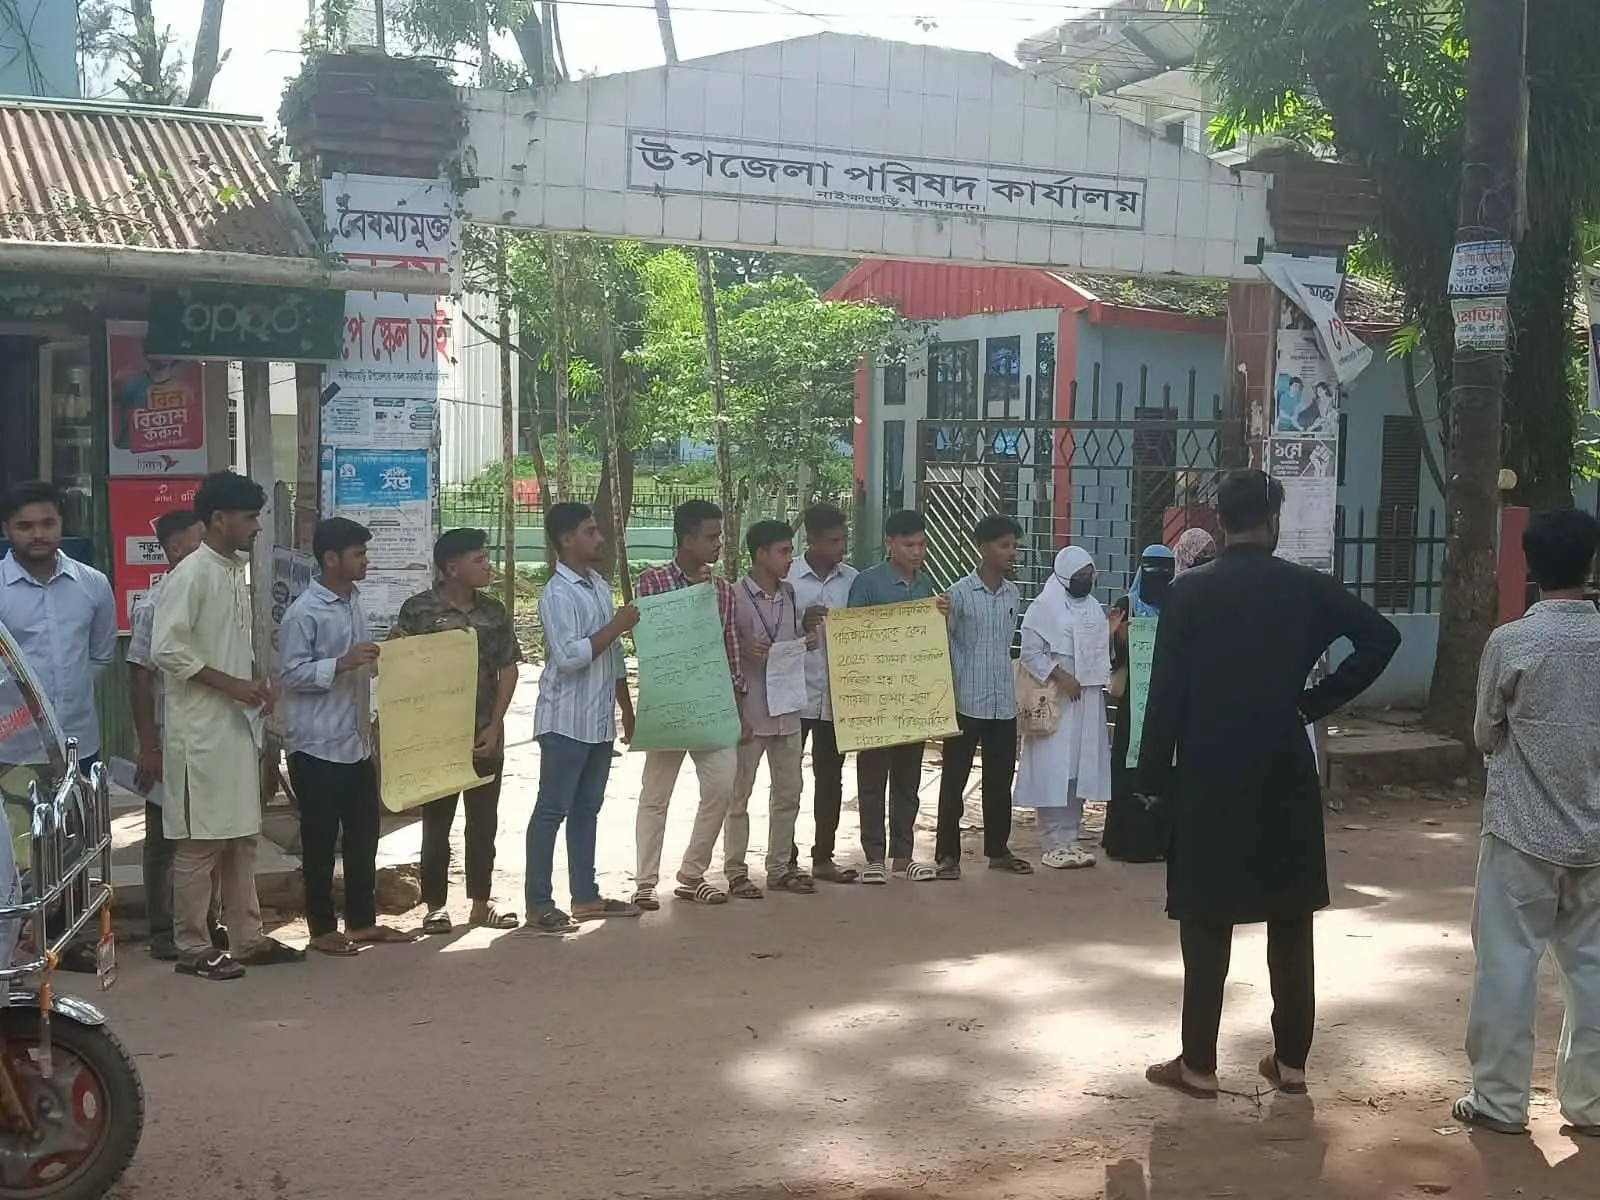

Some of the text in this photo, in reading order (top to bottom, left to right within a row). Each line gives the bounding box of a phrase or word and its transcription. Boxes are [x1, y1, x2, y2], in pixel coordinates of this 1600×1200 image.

[634, 137, 1139, 214] উপজেলা পরিষদ কার্যালয়
[371, 316, 411, 363] স্কেল
[416, 308, 452, 363] চাই
[134, 408, 188, 429] বিকাশ
[142, 425, 183, 440] করুন
